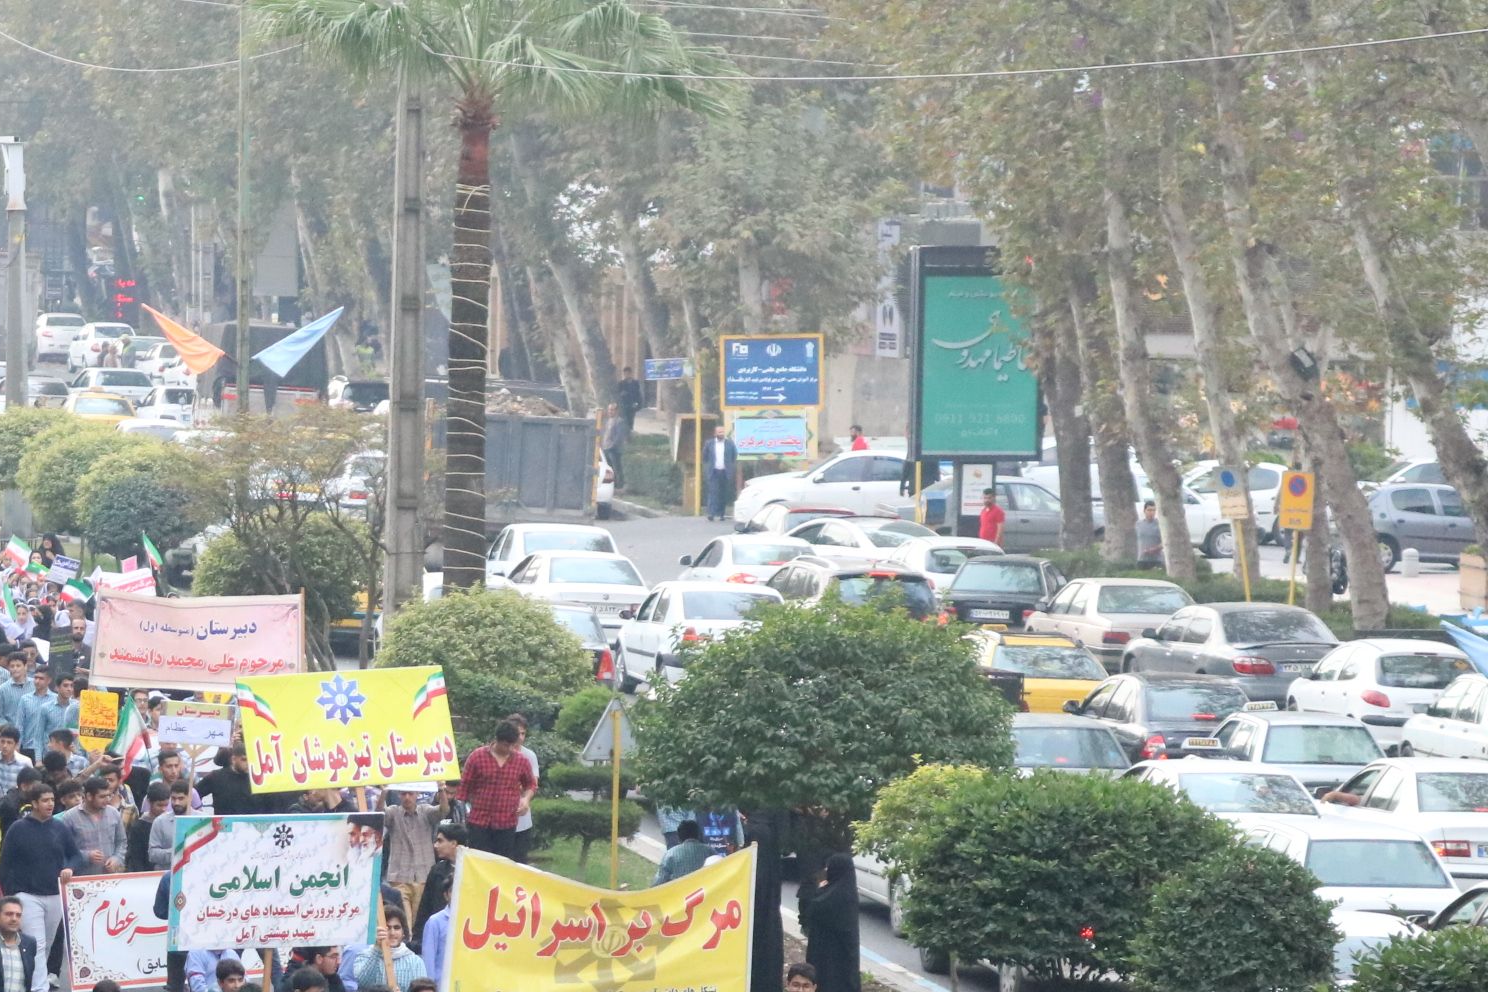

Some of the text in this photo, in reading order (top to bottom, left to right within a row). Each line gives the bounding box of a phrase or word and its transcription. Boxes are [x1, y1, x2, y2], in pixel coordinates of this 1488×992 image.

[139, 620, 158, 633] اول)
[196, 619, 257, 640] دبیرستان
[110, 648, 285, 673] مرحوم علی محمد دانشمند
[176, 705, 221, 717] دبیرستان
[251, 734, 282, 785] آمل
[379, 731, 454, 778] دبیرستان
[209, 863, 350, 899] انجمن اسلامی
[197, 902, 360, 922] مرکز پرورش استعداد های درخشان
[462, 884, 742, 958] مرگ بر اسرائیل
[92, 898, 138, 953] عظام
[236, 925, 315, 944] شهید بهشتی آمل
